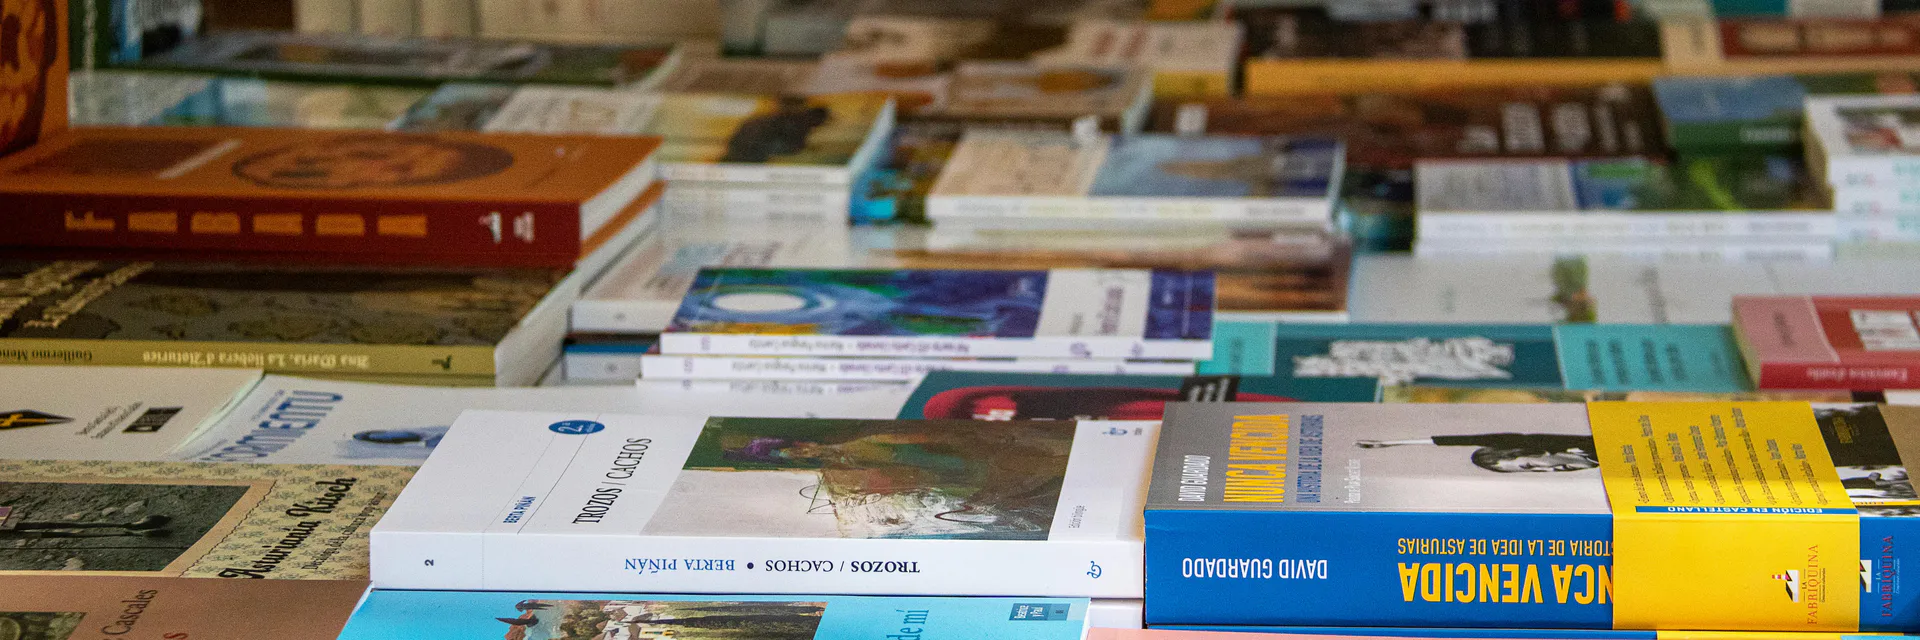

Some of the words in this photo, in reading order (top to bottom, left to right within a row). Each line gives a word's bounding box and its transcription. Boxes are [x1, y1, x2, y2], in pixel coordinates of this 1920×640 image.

[1228, 414, 1289, 461] VENCIDA
[1180, 454, 1211, 485] GUARDADO
[572, 487, 623, 525] TROZOS
[605, 437, 652, 480] CACHOS
[1223, 463, 1287, 503] NUNCA
[286, 477, 358, 516] Kitsch
[1178, 485, 1207, 502] DAVID
[503, 508, 525, 524] BERTA
[1397, 537, 1466, 555] ASTURIAS
[1470, 538, 1487, 555] DE
[1492, 538, 1523, 556] IDEA
[1527, 539, 1544, 556] LA
[1548, 539, 1565, 556] DE
[624, 558, 678, 574] PIÑÁN
[684, 558, 736, 571] BERTA
[765, 559, 834, 573] CACHOS
[850, 560, 921, 573] TROZOS
[1182, 557, 1273, 579] GUARDADO
[1278, 559, 1328, 579] DAVID
[1397, 562, 1544, 604] VENCIDA
[1807, 544, 1821, 625] FABRIQUINA
[1882, 535, 1896, 617] FABRIQUINA
[101, 589, 158, 635] Cascales
[896, 609, 930, 625] mí
